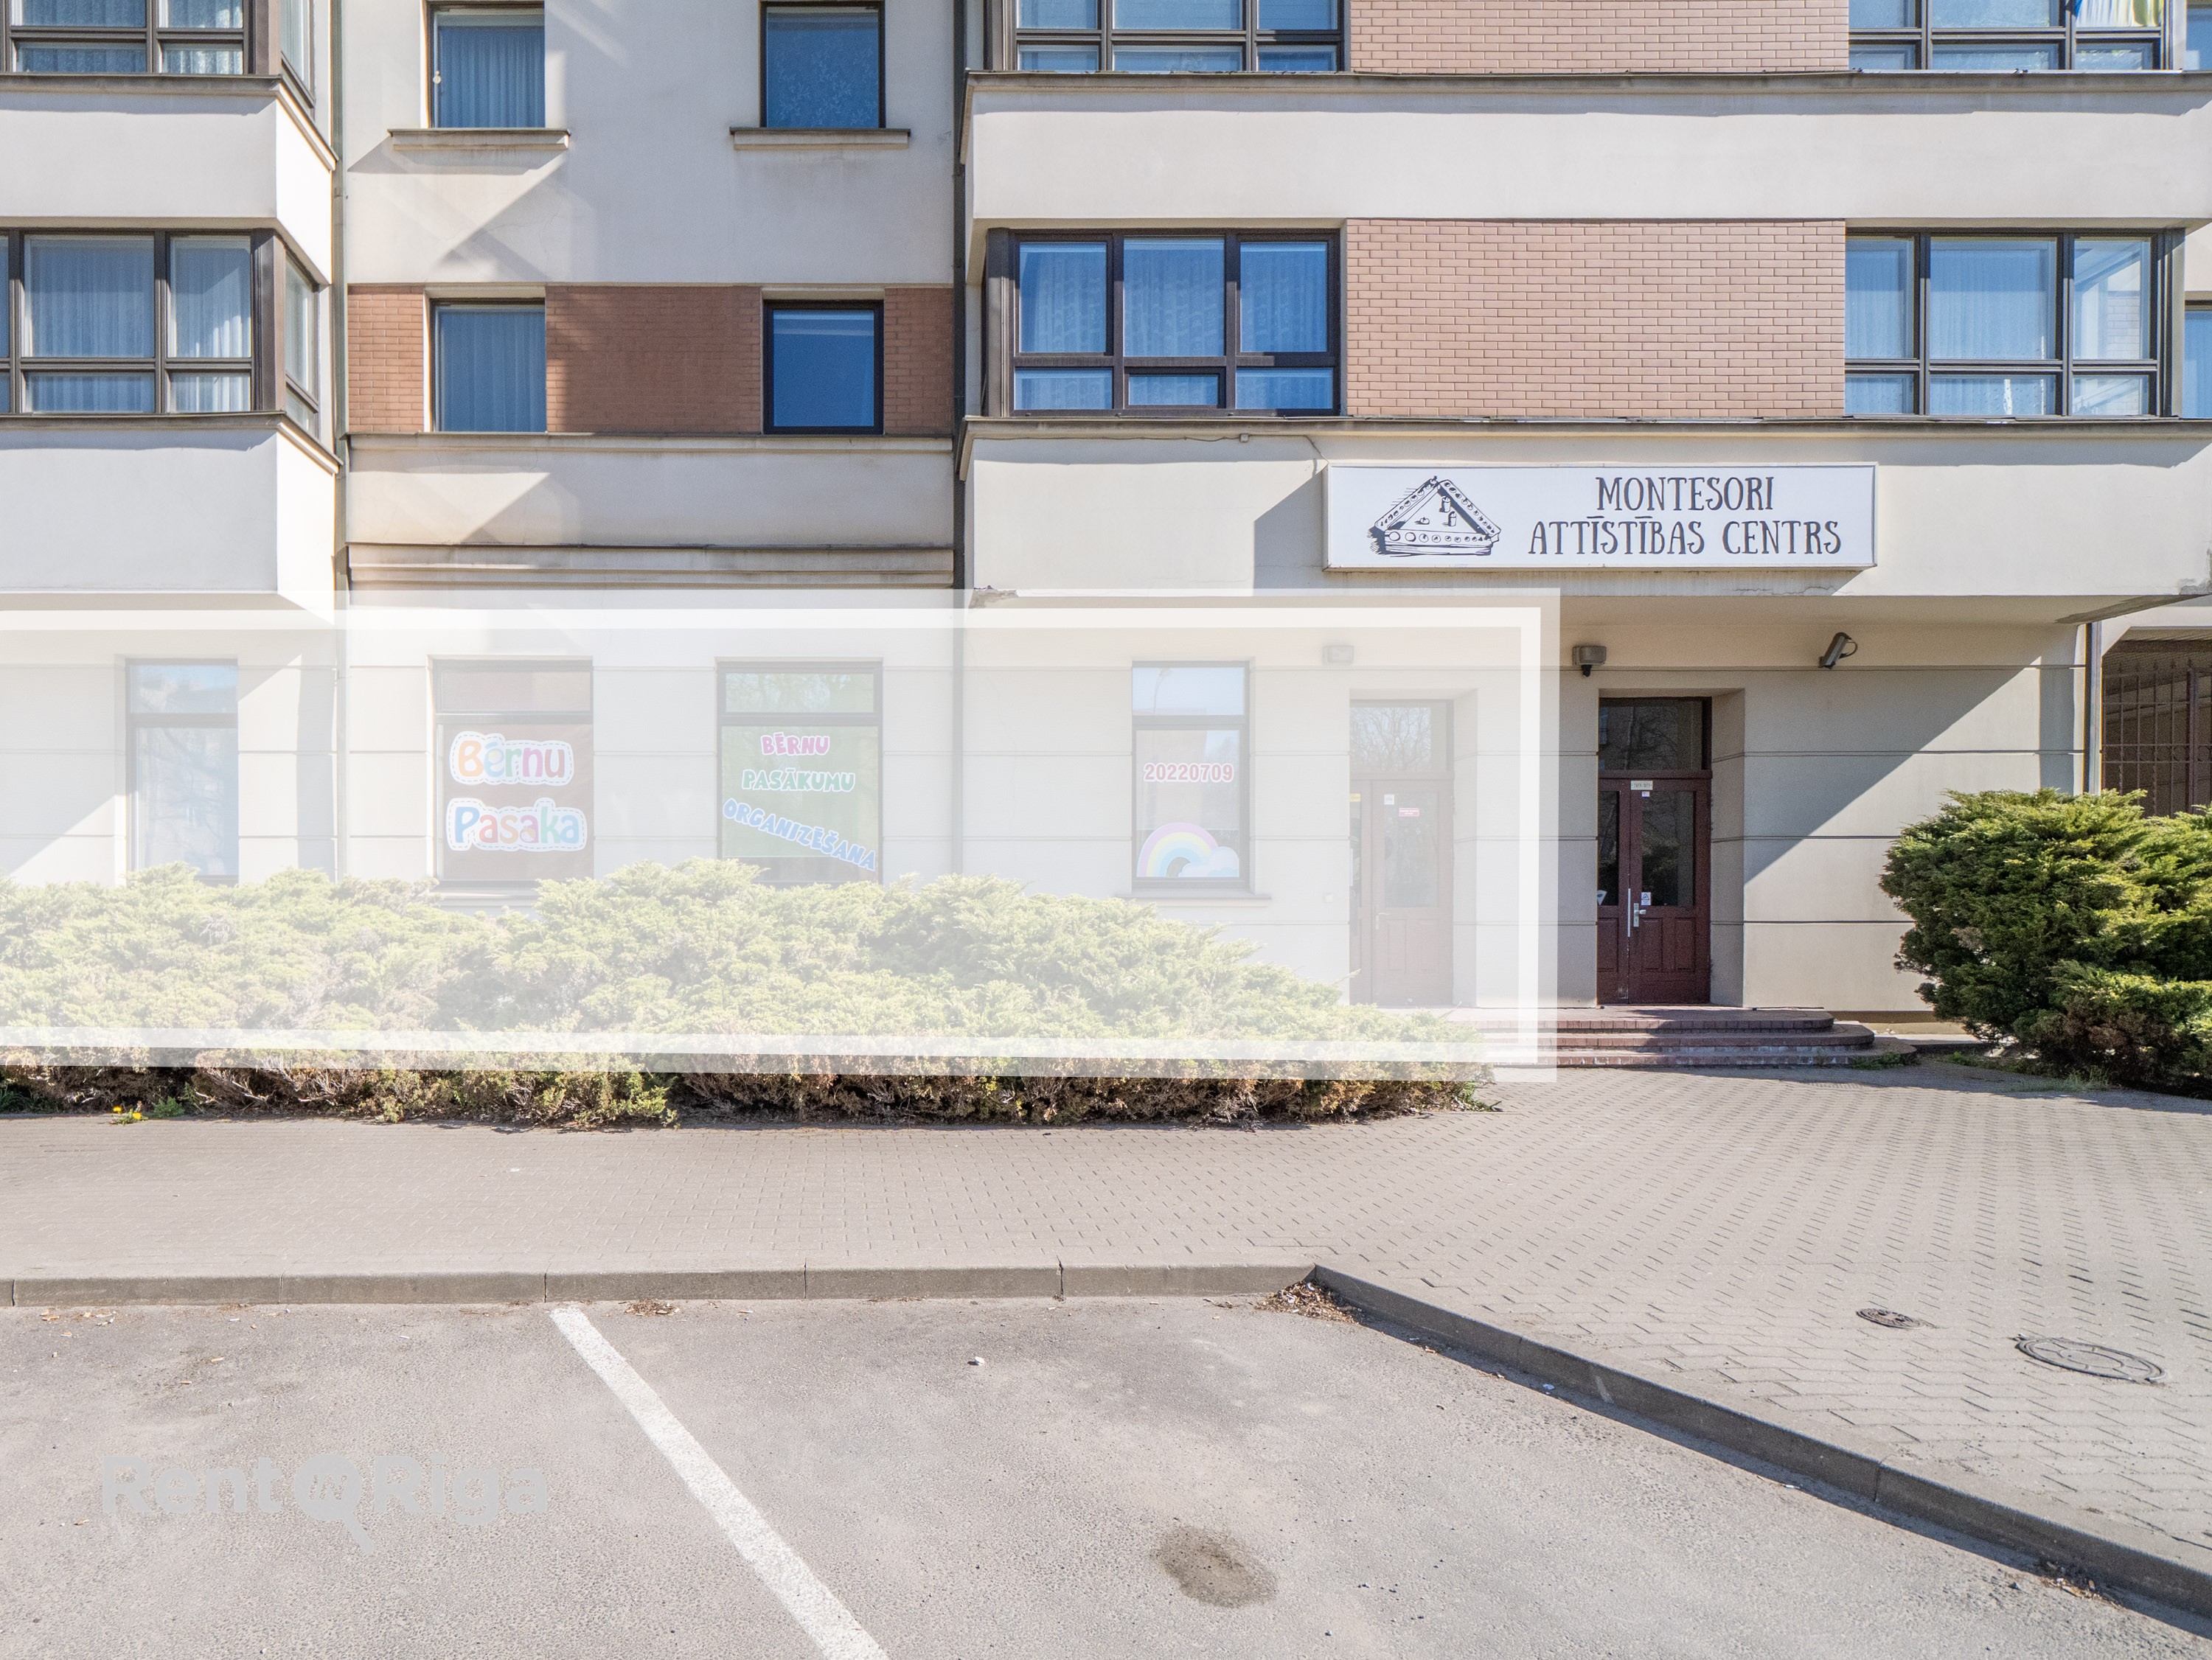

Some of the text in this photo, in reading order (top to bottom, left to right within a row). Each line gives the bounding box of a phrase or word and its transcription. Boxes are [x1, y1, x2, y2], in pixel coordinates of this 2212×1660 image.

[1596, 476, 1774, 511] MONTESORI
[1528, 515, 1843, 555] ATTĪSTĪBAS CENTRS
[458, 739, 566, 778] Bērnu
[761, 733, 830, 756] BĒRNU
[742, 769, 855, 792] PASĀKUMU
[1144, 764, 1233, 781] 20220709
[454, 804, 580, 844] Pasaka
[723, 798, 876, 871] ORGANIZĒŠANA
